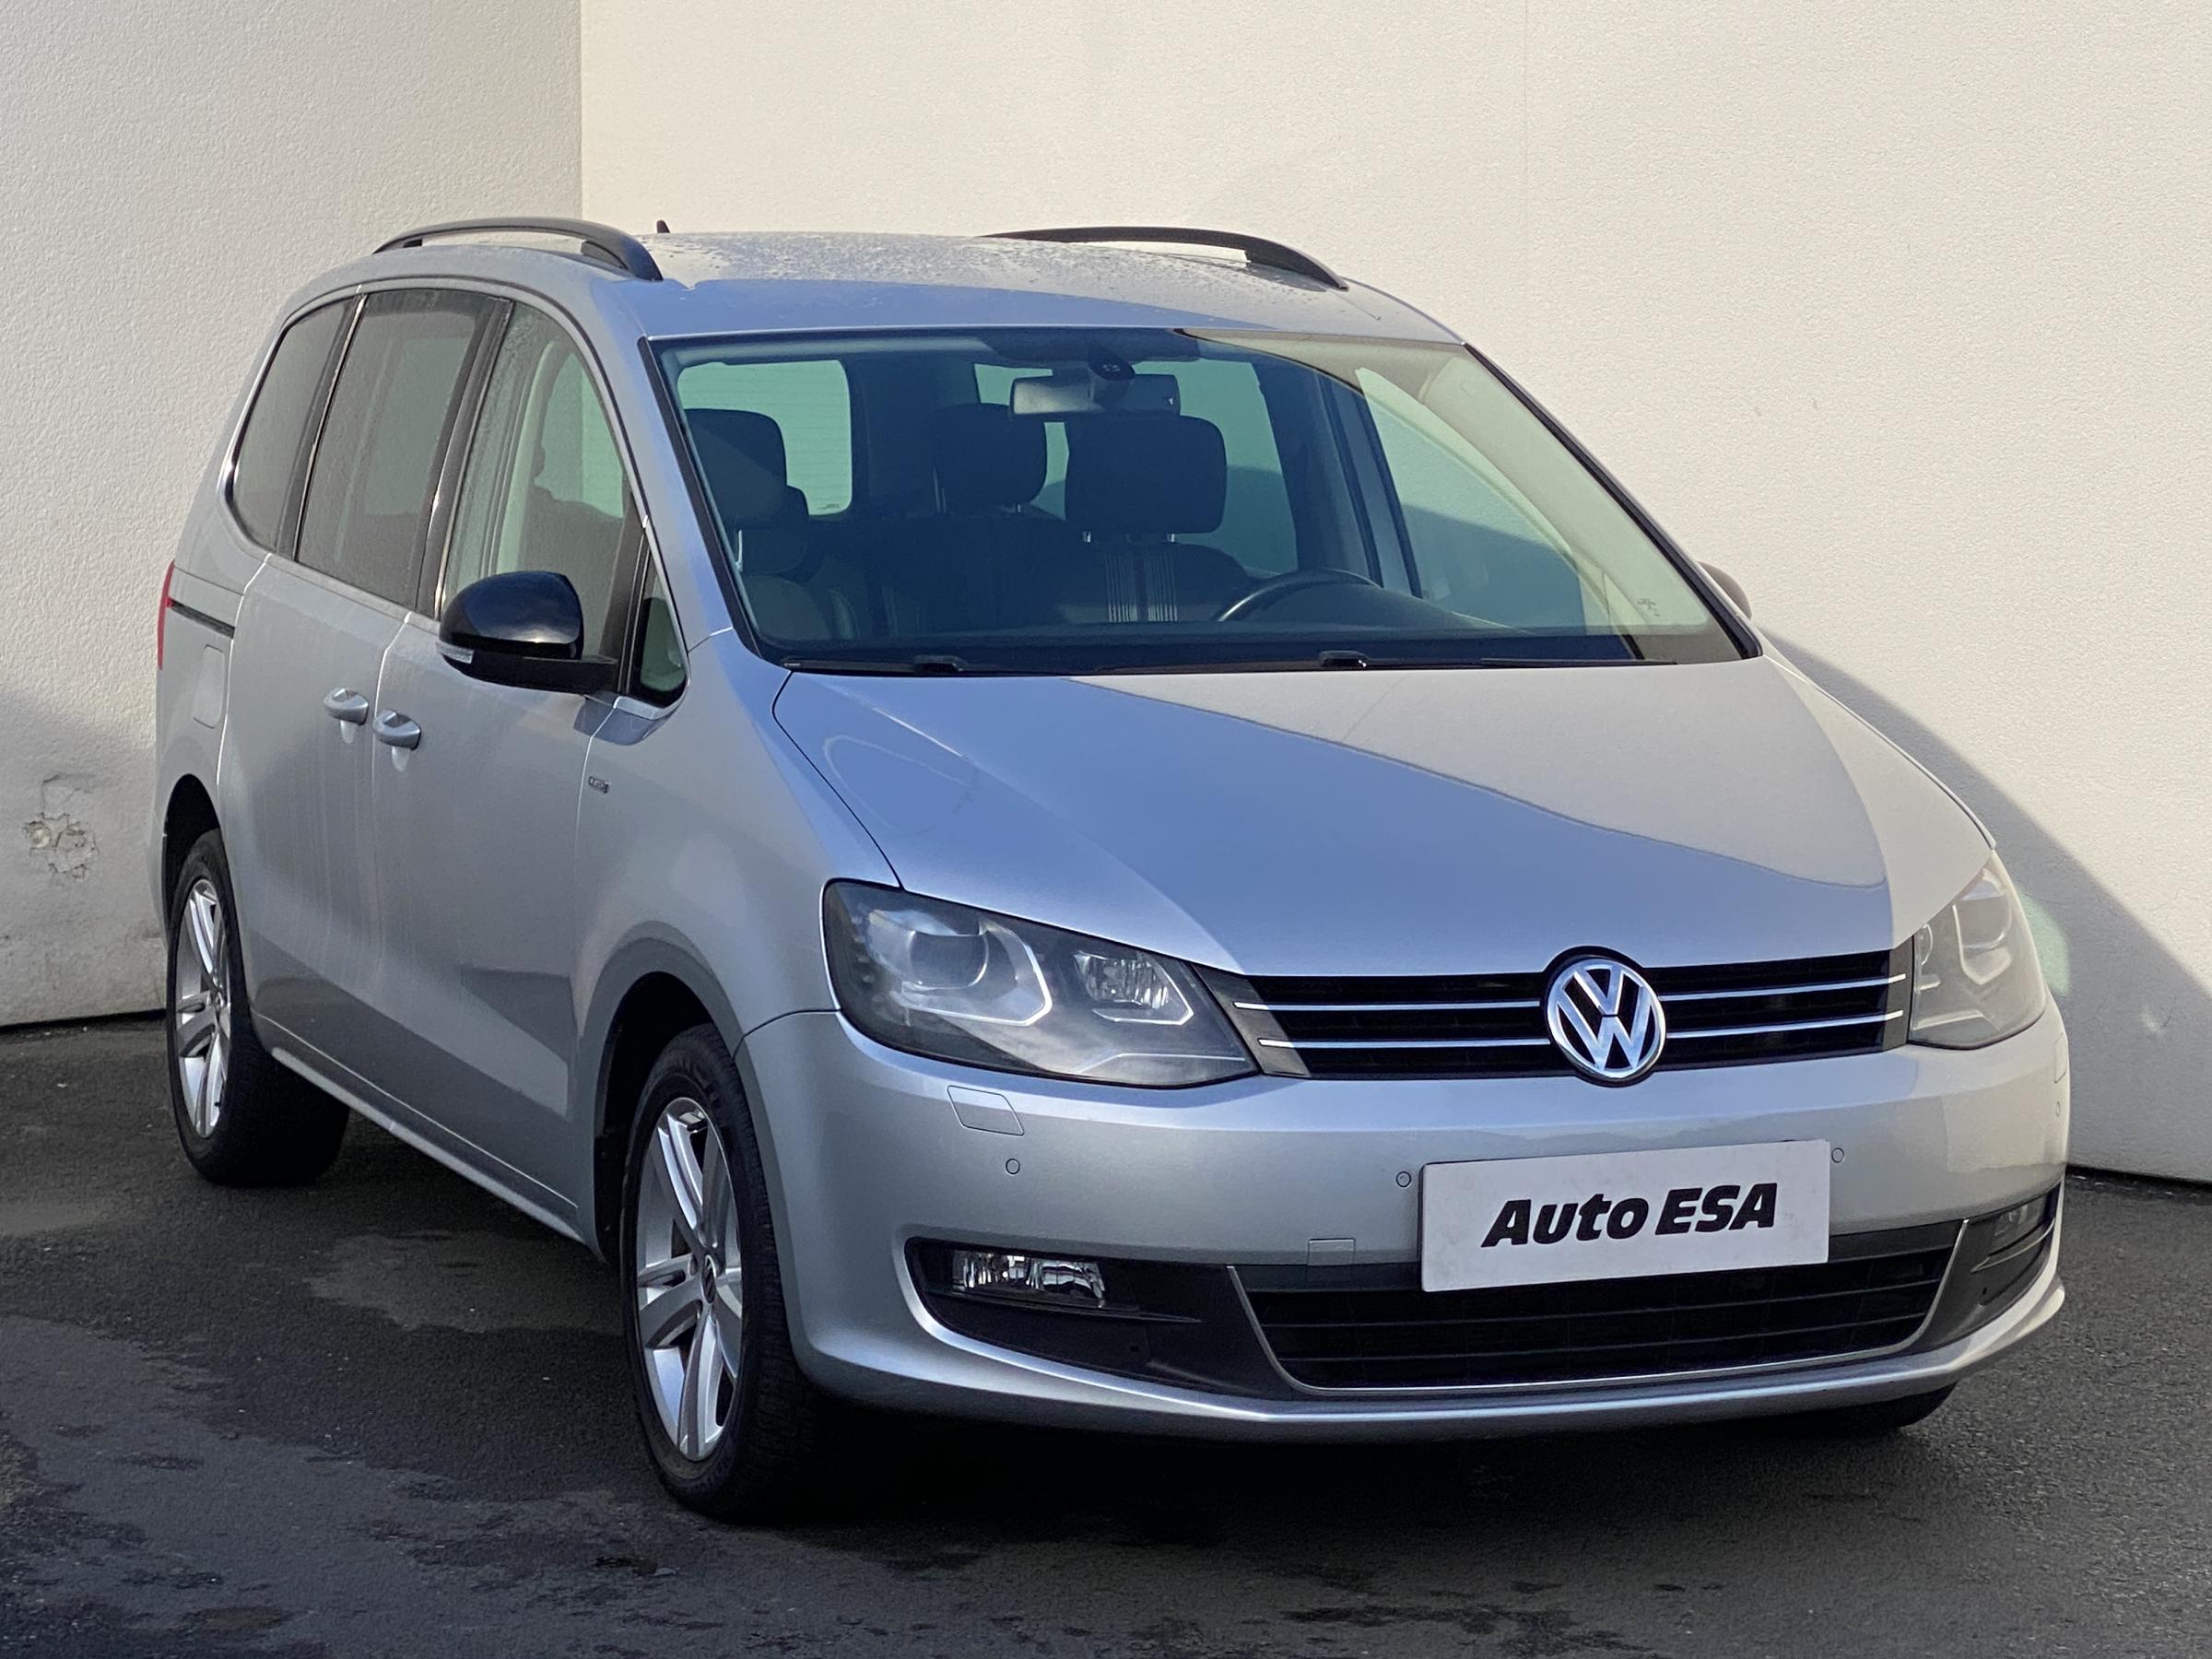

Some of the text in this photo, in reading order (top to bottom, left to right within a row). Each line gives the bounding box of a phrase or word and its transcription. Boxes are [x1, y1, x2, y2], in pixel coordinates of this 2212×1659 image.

[1550, 961, 1661, 1076] VW
[1480, 1182, 1778, 1248] Auto ESA
